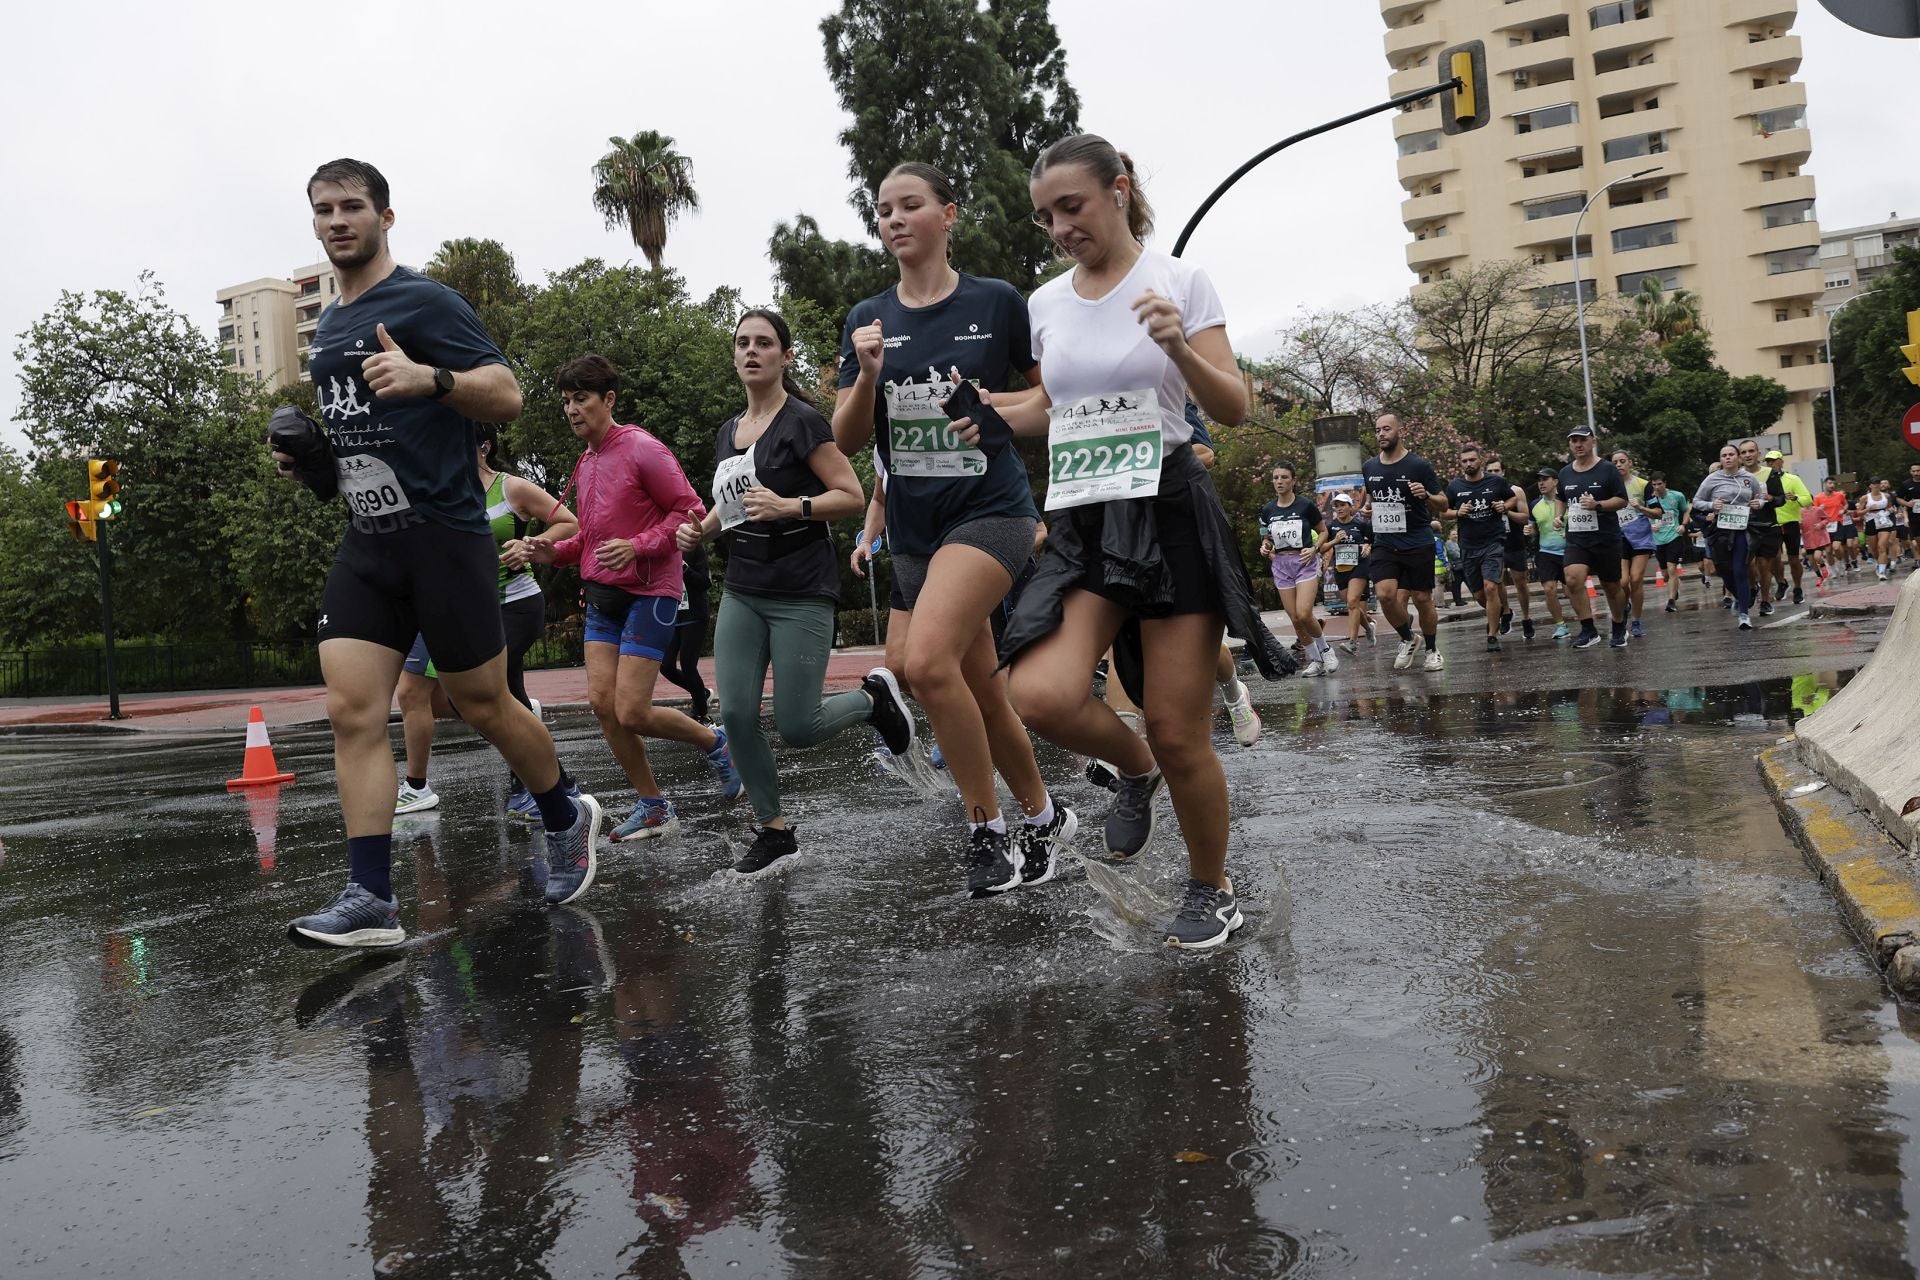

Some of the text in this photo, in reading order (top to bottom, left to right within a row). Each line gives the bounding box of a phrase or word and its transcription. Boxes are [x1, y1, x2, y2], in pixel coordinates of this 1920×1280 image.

[882, 335, 911, 343] undación
[893, 425, 975, 451] 2210
[1056, 441, 1154, 481] 22229
[1378, 514, 1401, 523] 1330
[1571, 514, 1593, 523] 6692
[1276, 530, 1297, 540] 1476
